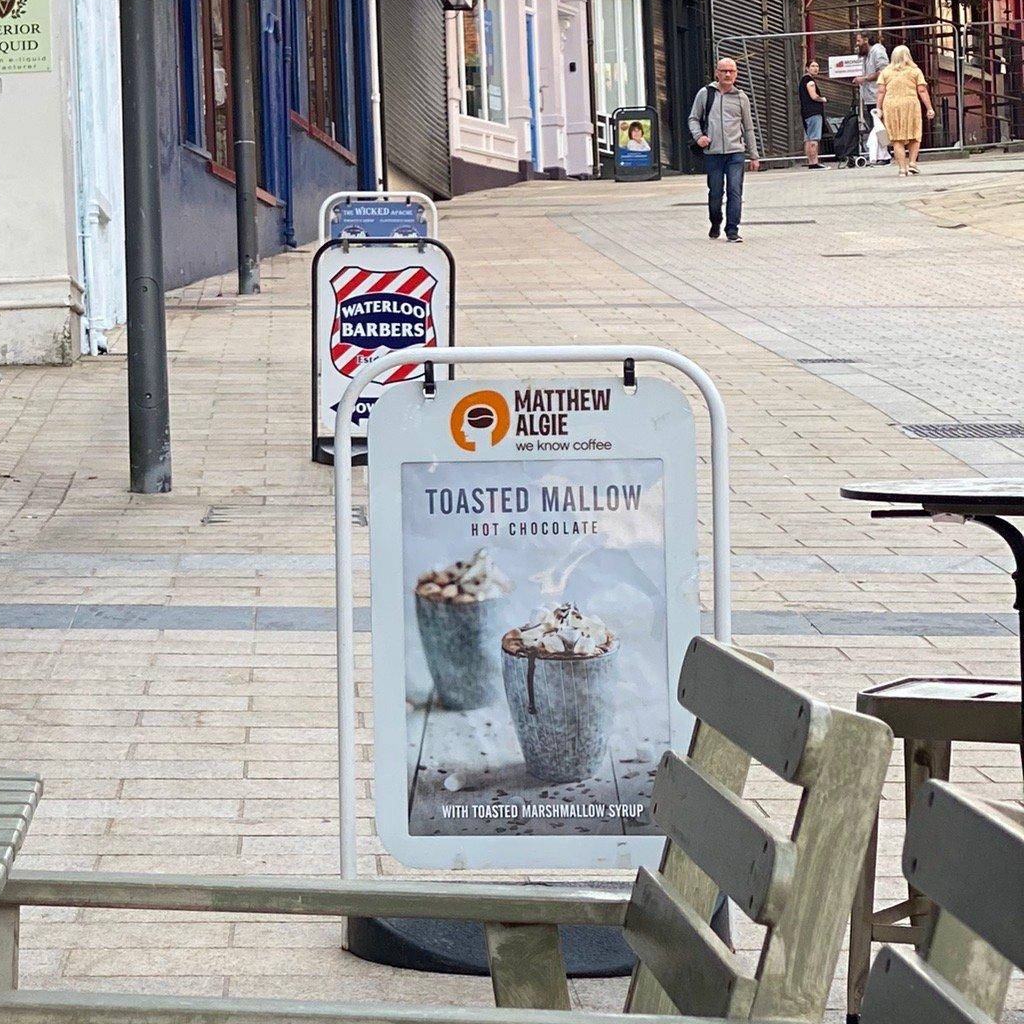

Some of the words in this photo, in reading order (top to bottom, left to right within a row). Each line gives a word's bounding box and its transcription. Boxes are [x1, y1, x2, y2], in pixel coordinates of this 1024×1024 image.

[355, 206, 390, 216] WICKED
[342, 299, 425, 319] WATERLOO
[342, 322, 425, 337] BARBERS
[514, 388, 611, 412] MATTHEW
[515, 414, 568, 436] ALGIE
[515, 441, 534, 451] we
[536, 439, 571, 451] know
[573, 439, 612, 451] coffee
[425, 487, 529, 515] TOASTED
[542, 484, 642, 512] MALLOW
[471, 523, 499, 536] HOT
[508, 521, 598, 535] CHOCOLATE
[442, 805, 469, 818] WITH
[472, 805, 518, 818] TOASTED
[522, 804, 606, 818] MARSHMALLOW
[609, 804, 644, 818] SYRUP
